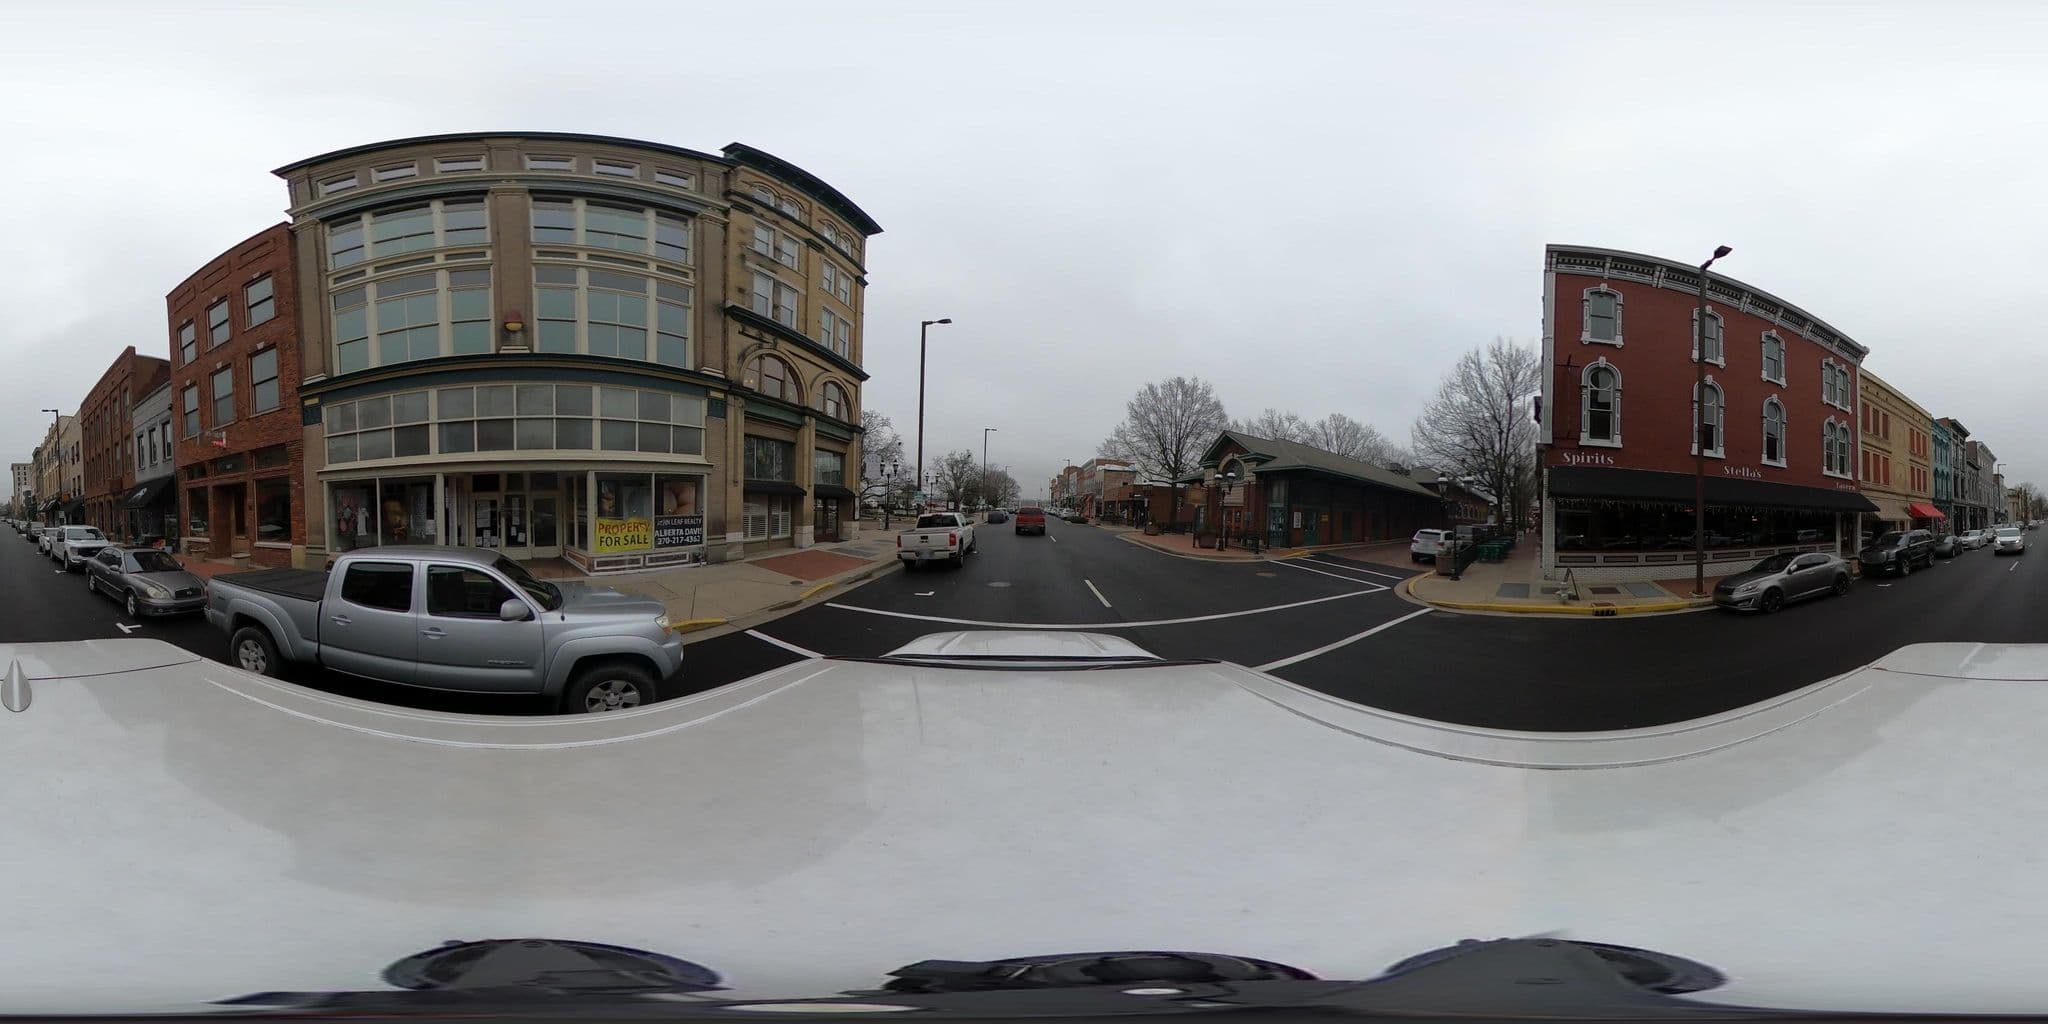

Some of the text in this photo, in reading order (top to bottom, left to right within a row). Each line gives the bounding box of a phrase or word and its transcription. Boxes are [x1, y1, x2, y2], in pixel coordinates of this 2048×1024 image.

[1563, 452, 1615, 465] Spirits
[1724, 465, 1762, 478] Stella's
[598, 521, 650, 534] PROPERTY
[684, 517, 702, 525] REALTY
[654, 527, 702, 537] ALBERTA DAVIS
[599, 534, 649, 547] FOR SALE
